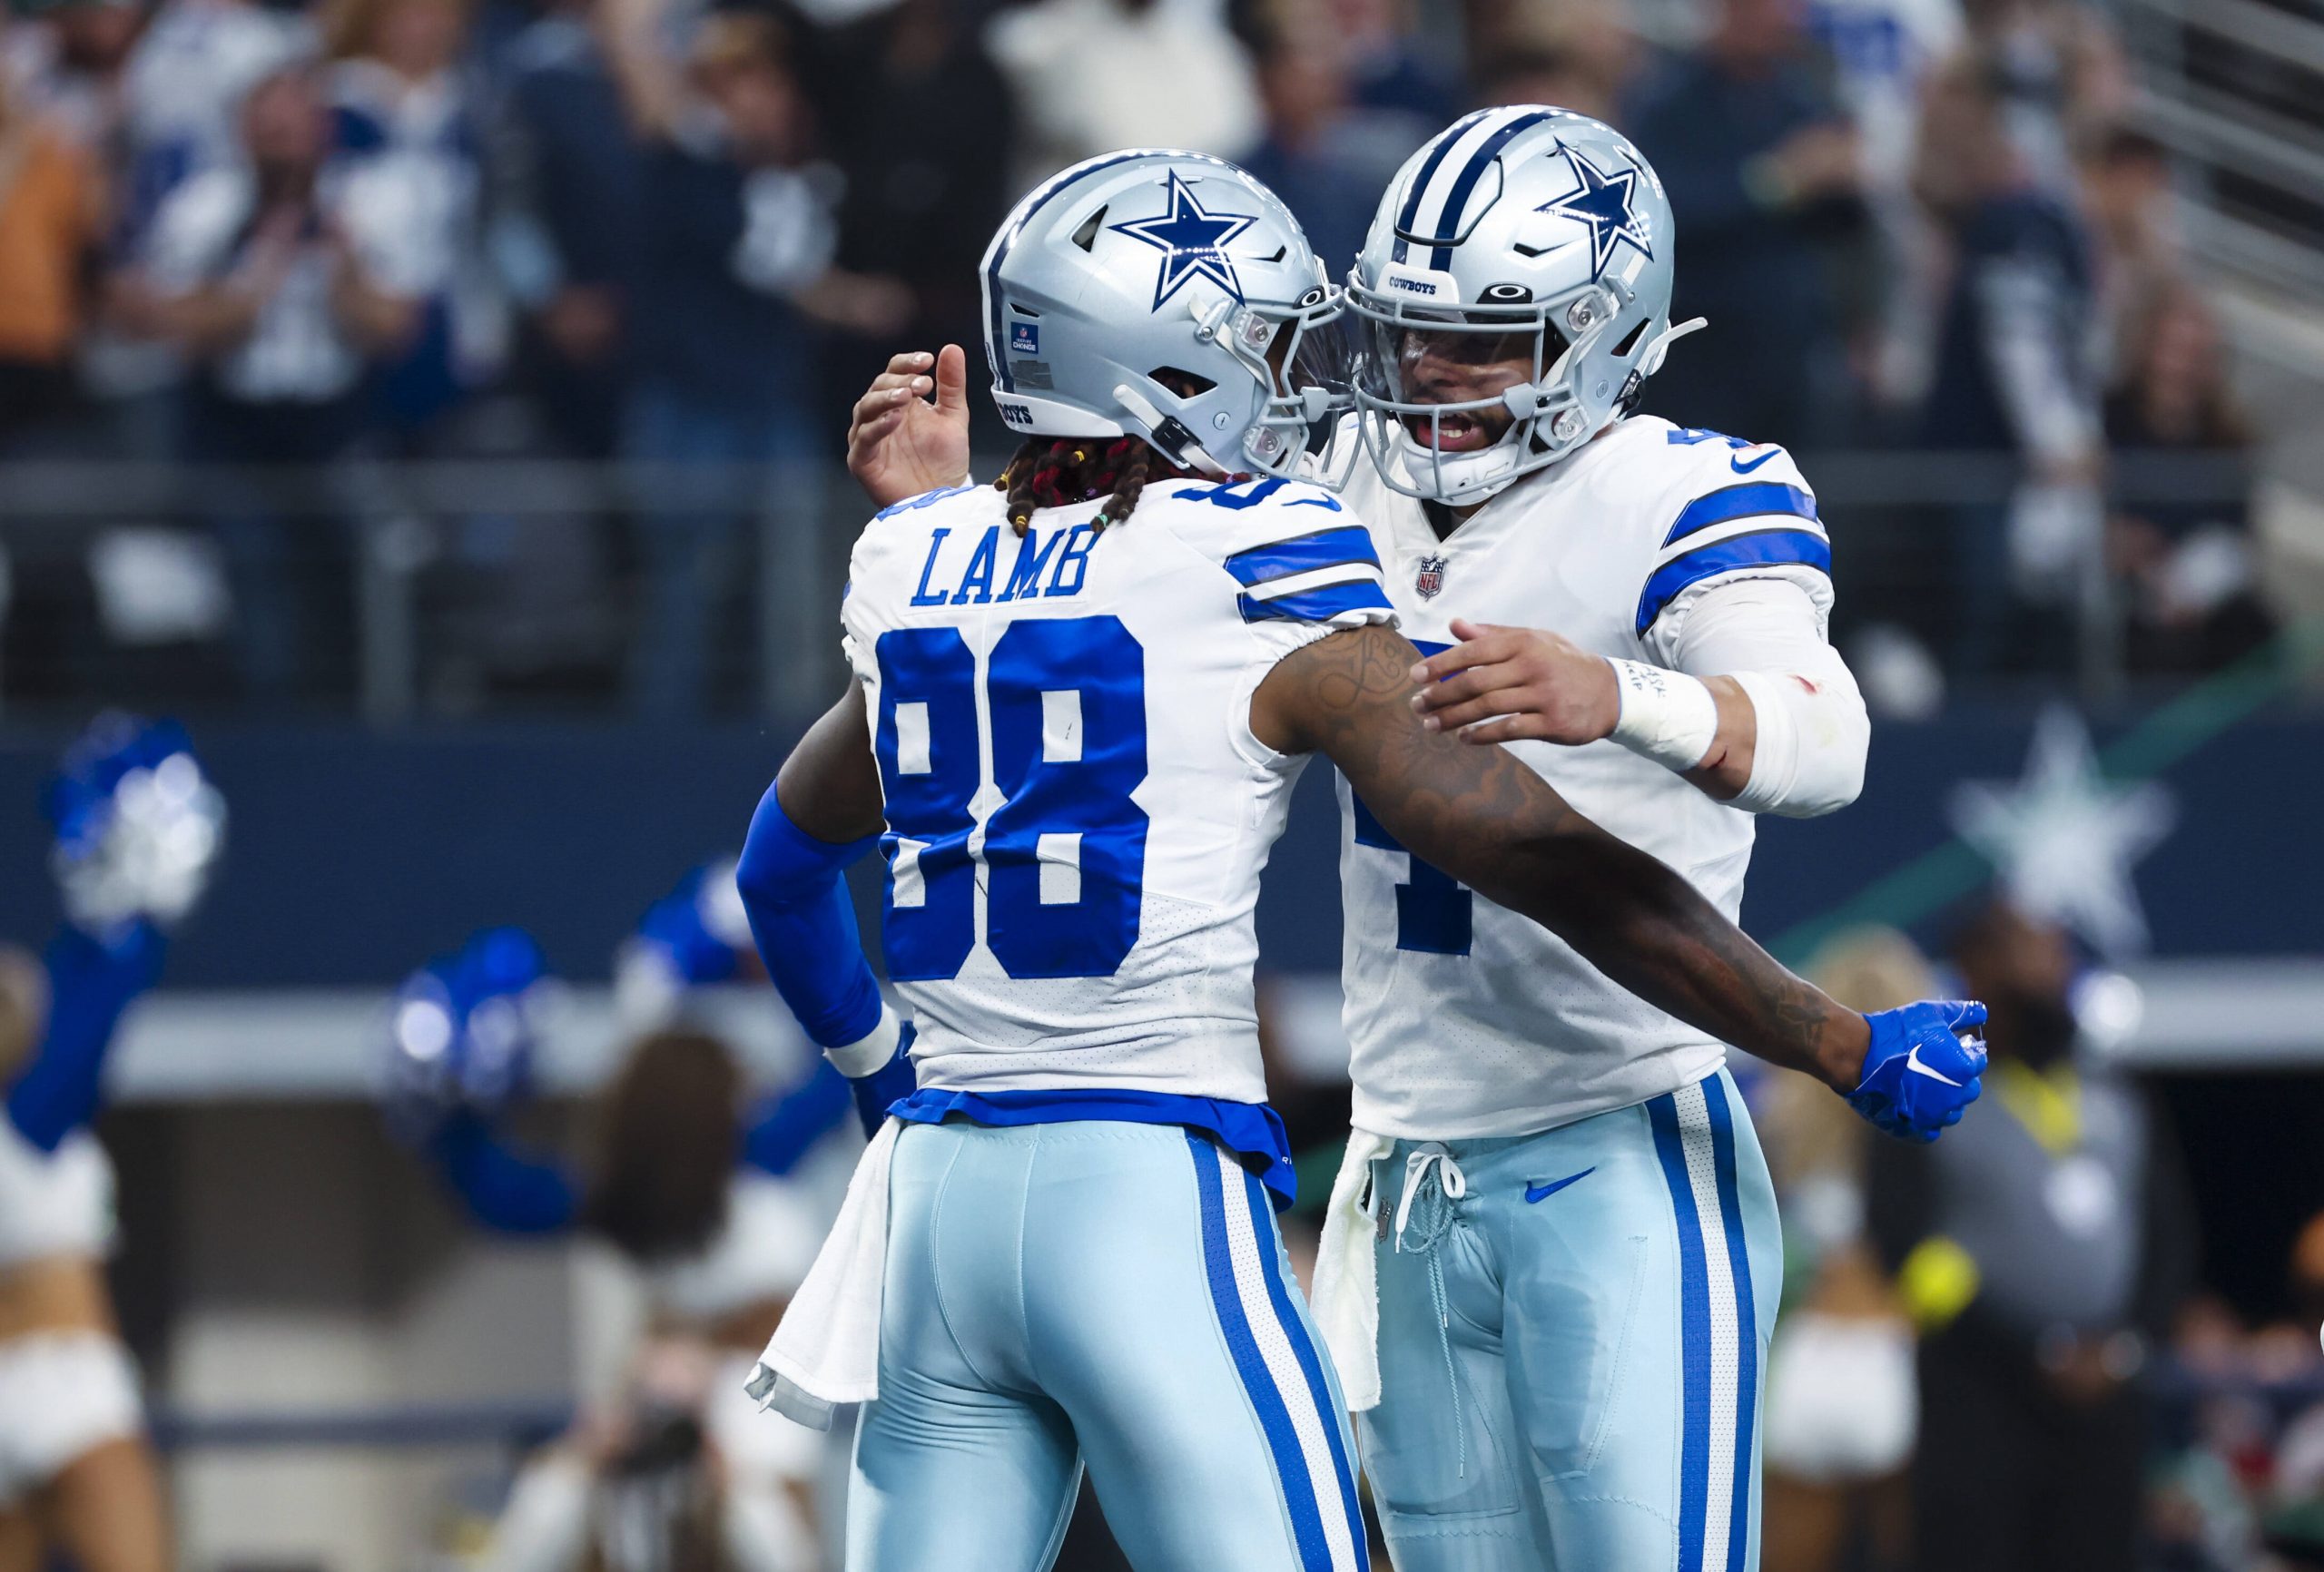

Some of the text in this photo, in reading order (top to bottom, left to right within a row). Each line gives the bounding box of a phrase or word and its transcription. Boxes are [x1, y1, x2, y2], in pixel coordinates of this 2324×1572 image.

[1389, 276, 1436, 295] COWBOYS
[910, 524, 1103, 607] LAMB
[1419, 573, 1439, 591] NFL
[875, 614, 1150, 981] 88
